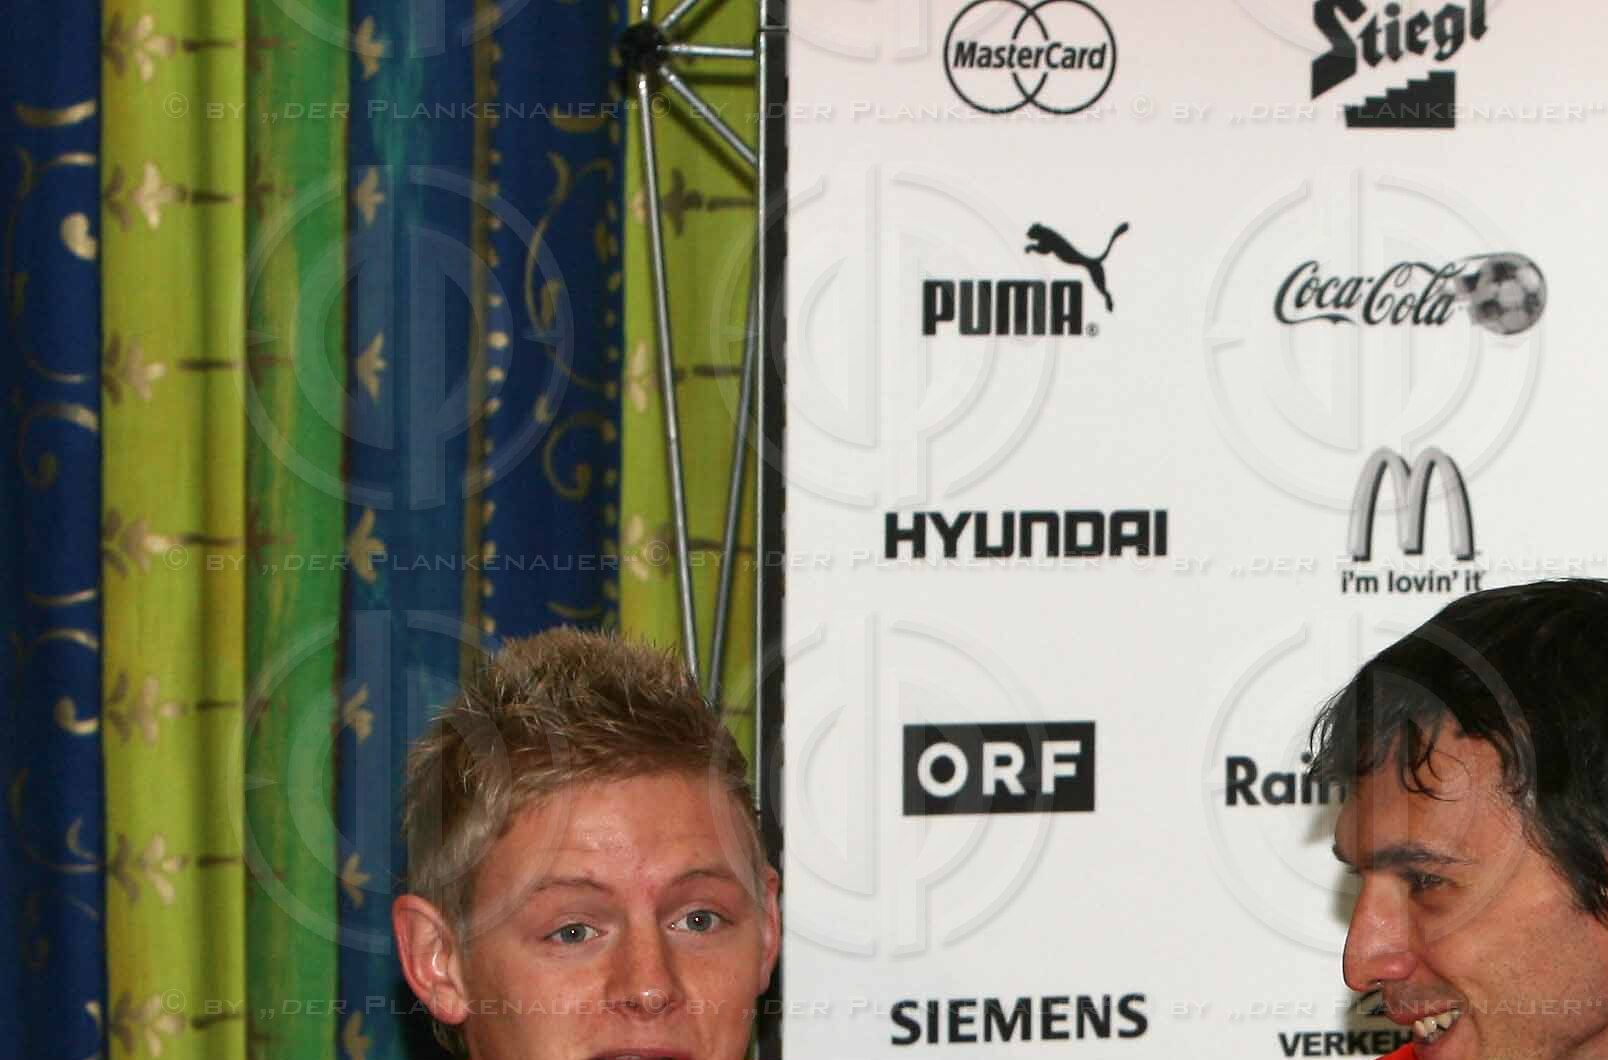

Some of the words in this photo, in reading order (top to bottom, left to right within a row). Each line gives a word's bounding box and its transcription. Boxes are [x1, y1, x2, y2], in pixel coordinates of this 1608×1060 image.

[953, 39, 1107, 70] MasterCard
[1311, 0, 1488, 101] Stiegl
[922, 280, 1083, 335] PUMA
[1274, 261, 1464, 326] Coca-Cola
[885, 509, 1168, 559] HYUNDAI
[1466, 571, 1482, 592] it
[917, 741, 1081, 797] ORF
[890, 994, 1148, 1046] SIEMENS
